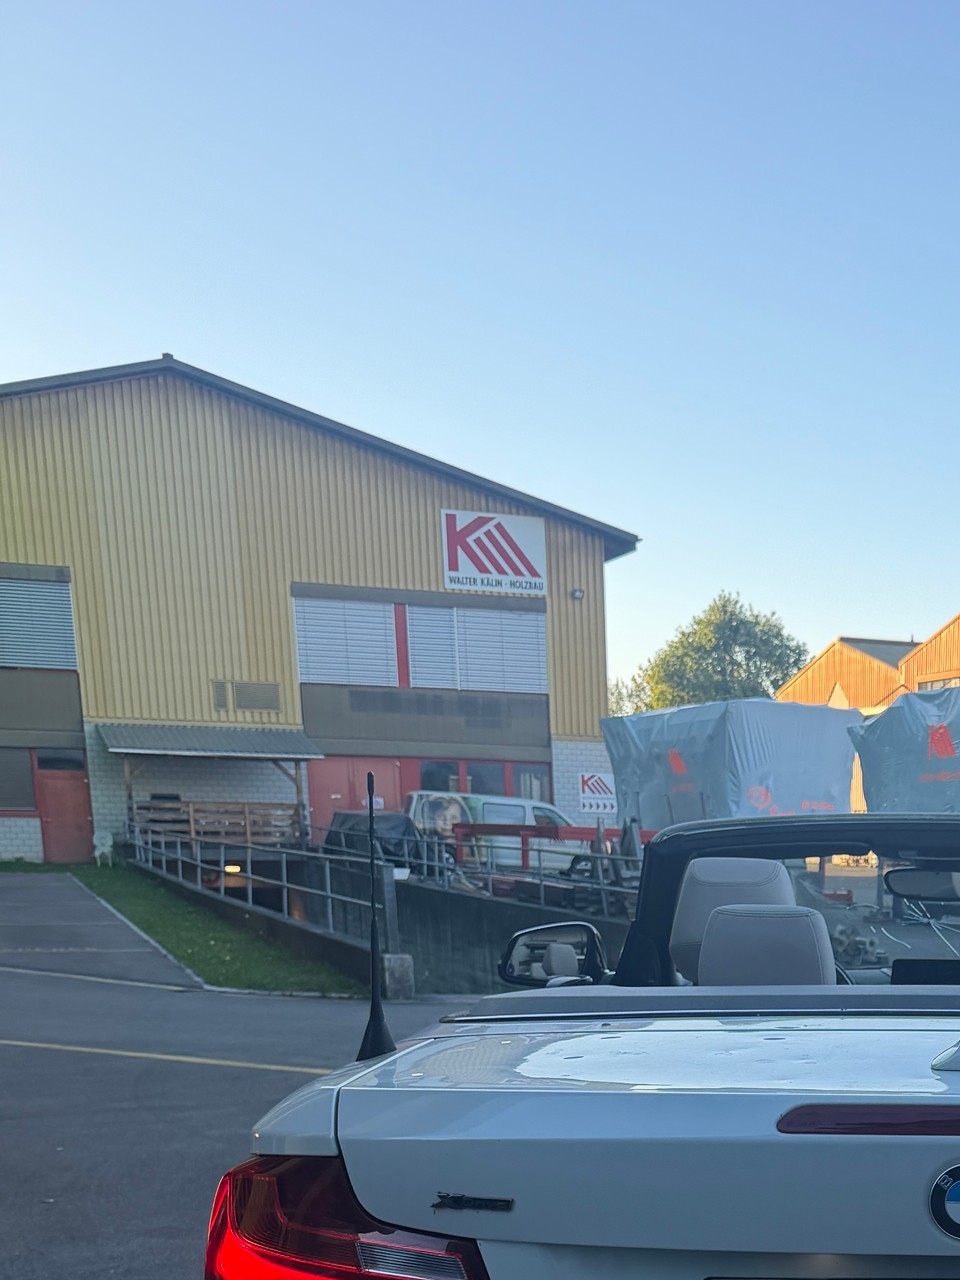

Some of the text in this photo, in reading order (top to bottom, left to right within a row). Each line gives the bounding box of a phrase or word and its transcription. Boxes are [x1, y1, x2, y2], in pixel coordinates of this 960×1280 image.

[448, 575, 479, 587] WALTER
[480, 577, 503, 588] KÄLIN
[510, 580, 544, 591] HOLZBAU
